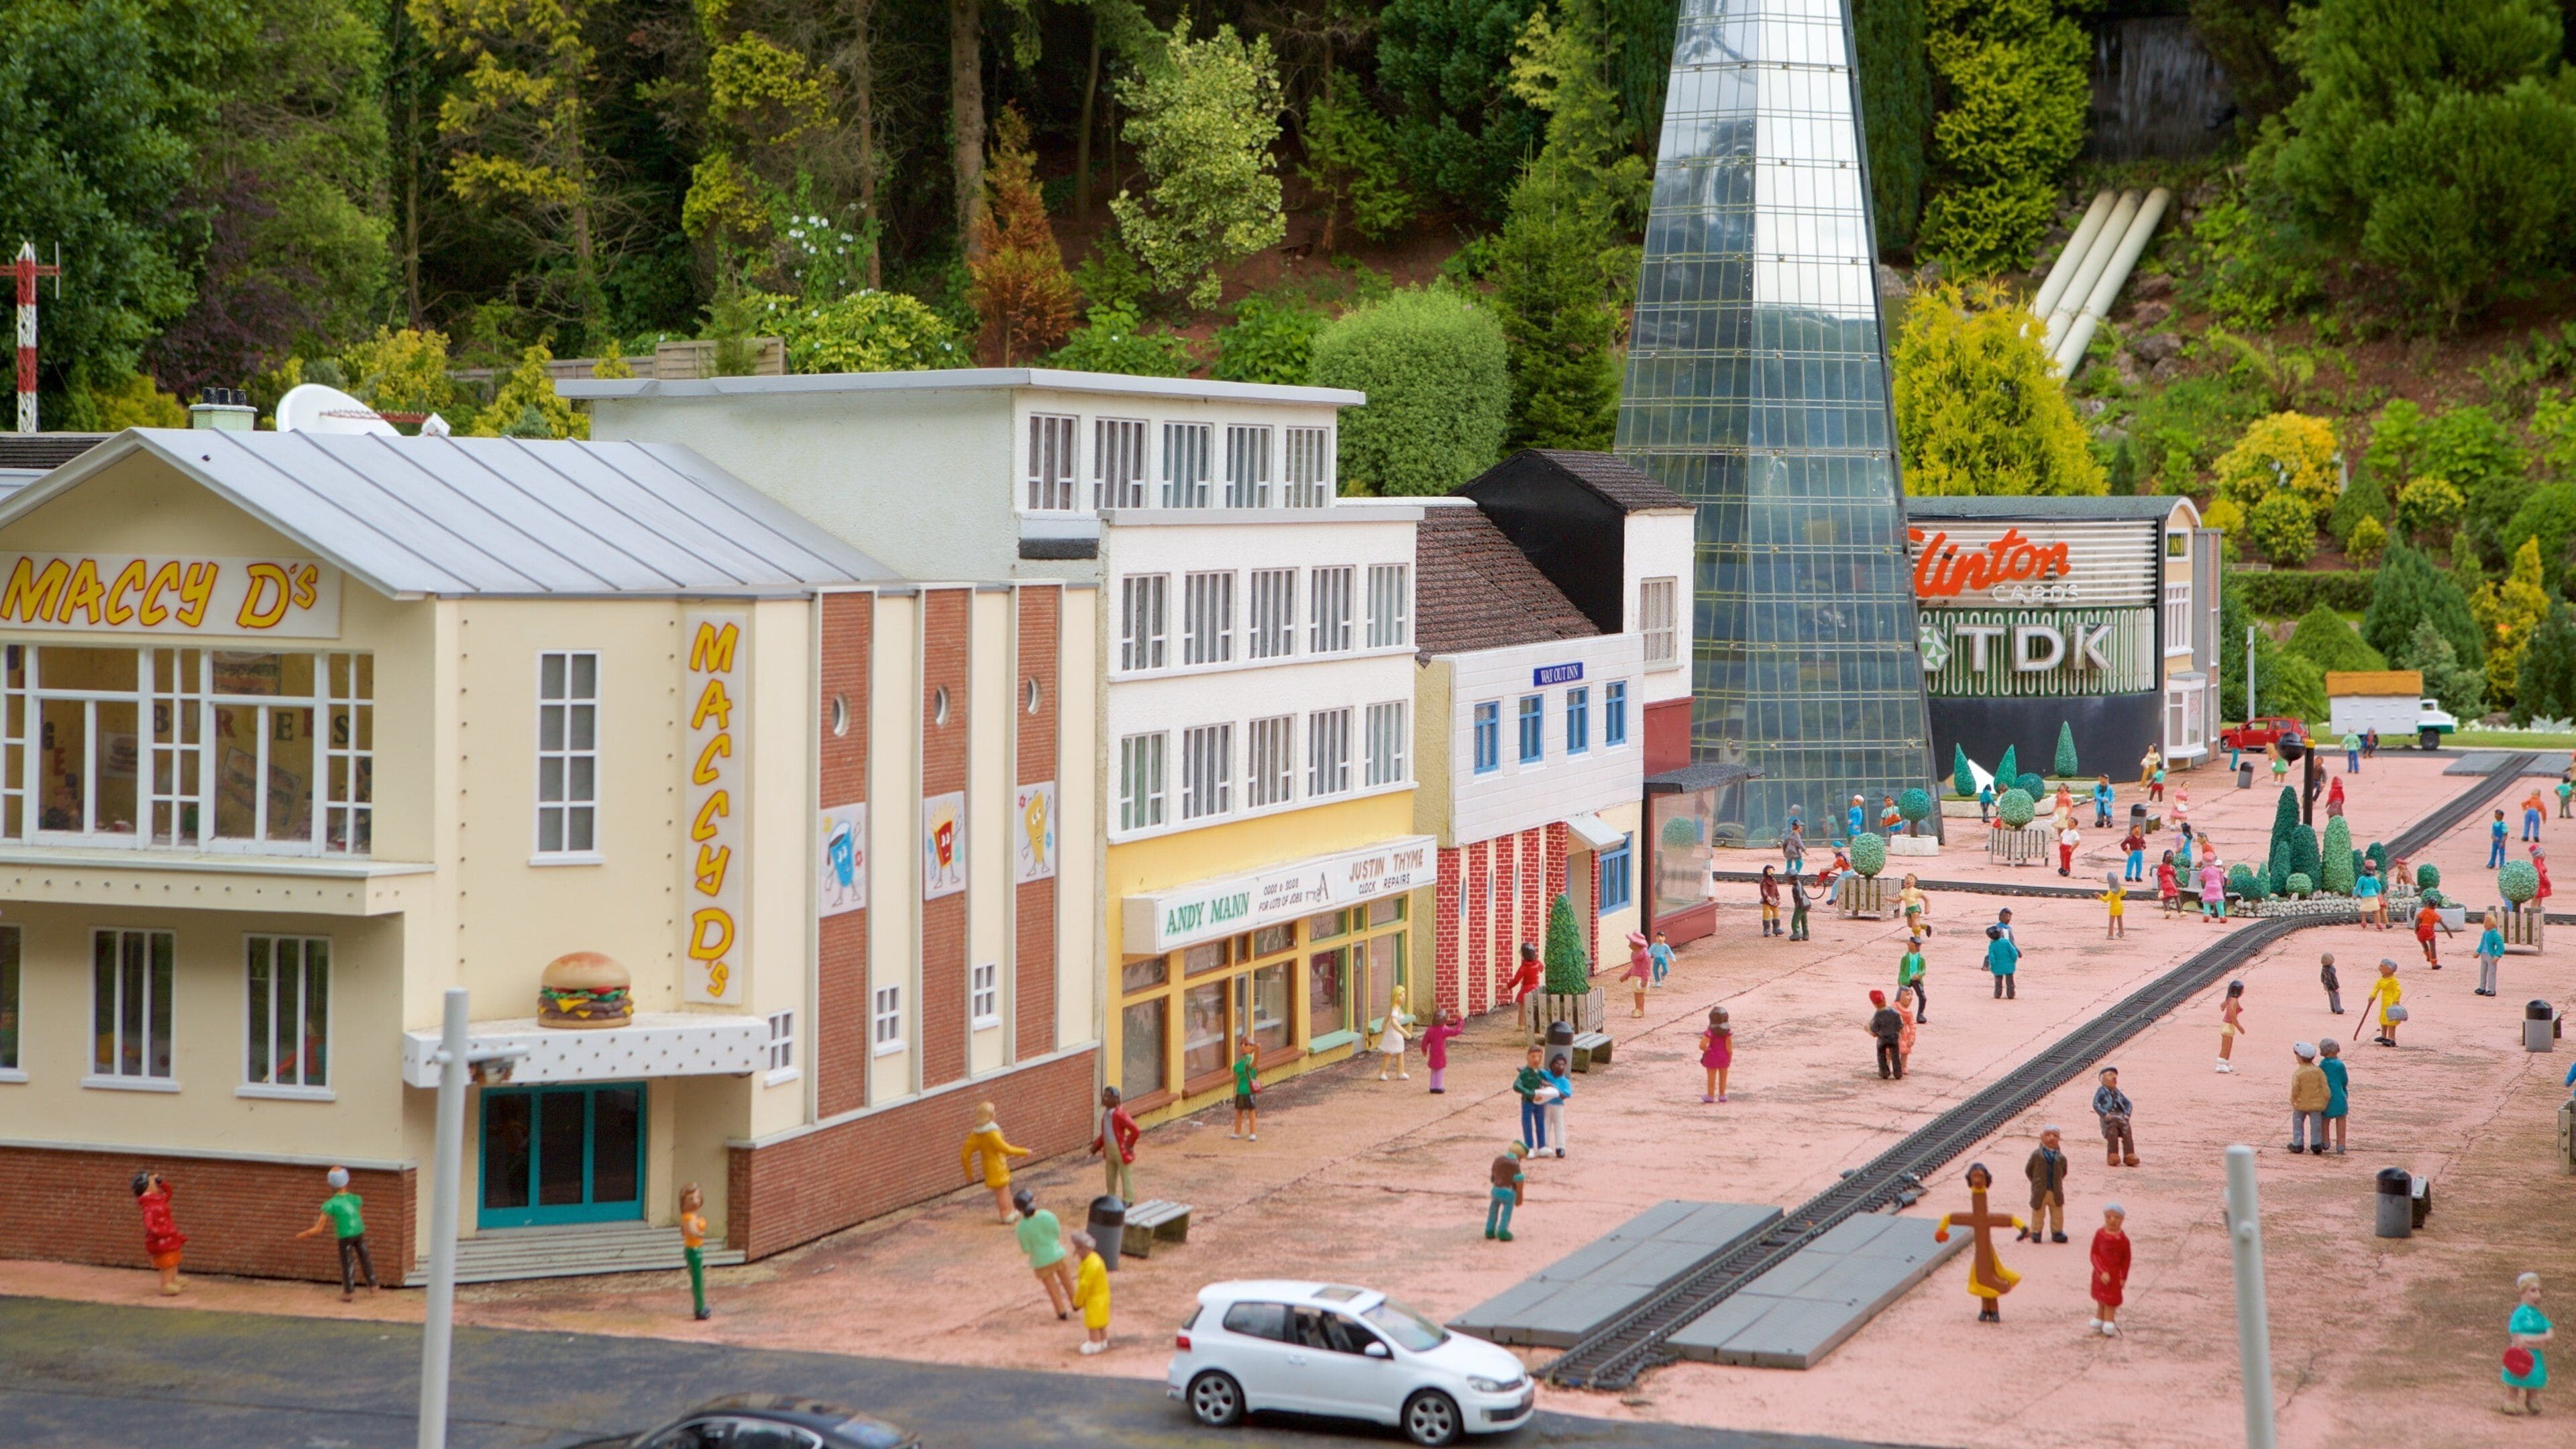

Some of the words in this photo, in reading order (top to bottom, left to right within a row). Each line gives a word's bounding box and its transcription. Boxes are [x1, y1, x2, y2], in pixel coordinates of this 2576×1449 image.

[1907, 527, 2072, 598] linton
[0, 555, 219, 627] MACCY
[1992, 584, 2079, 603] CARDS
[1953, 623, 2116, 672] TDK
[1540, 668, 1554, 684] WAY
[1554, 667, 1566, 682] OUT
[1566, 665, 1578, 680] INN
[690, 621, 740, 897] MACCY
[1349, 857, 1385, 883] JUSTIN
[1393, 848, 1424, 872] THYME
[1263, 883, 1277, 896] ODDS
[1358, 882, 1376, 895] CLOCK
[1383, 873, 1411, 890] REPAIRS
[1165, 902, 1205, 936] ANDY
[1210, 892, 1250, 924] MANN
[1258, 900, 1269, 912] FOR
[1269, 896, 1281, 909] LOTS
[1282, 895, 1289, 906] OF
[1289, 892, 1303, 904] JOBS
